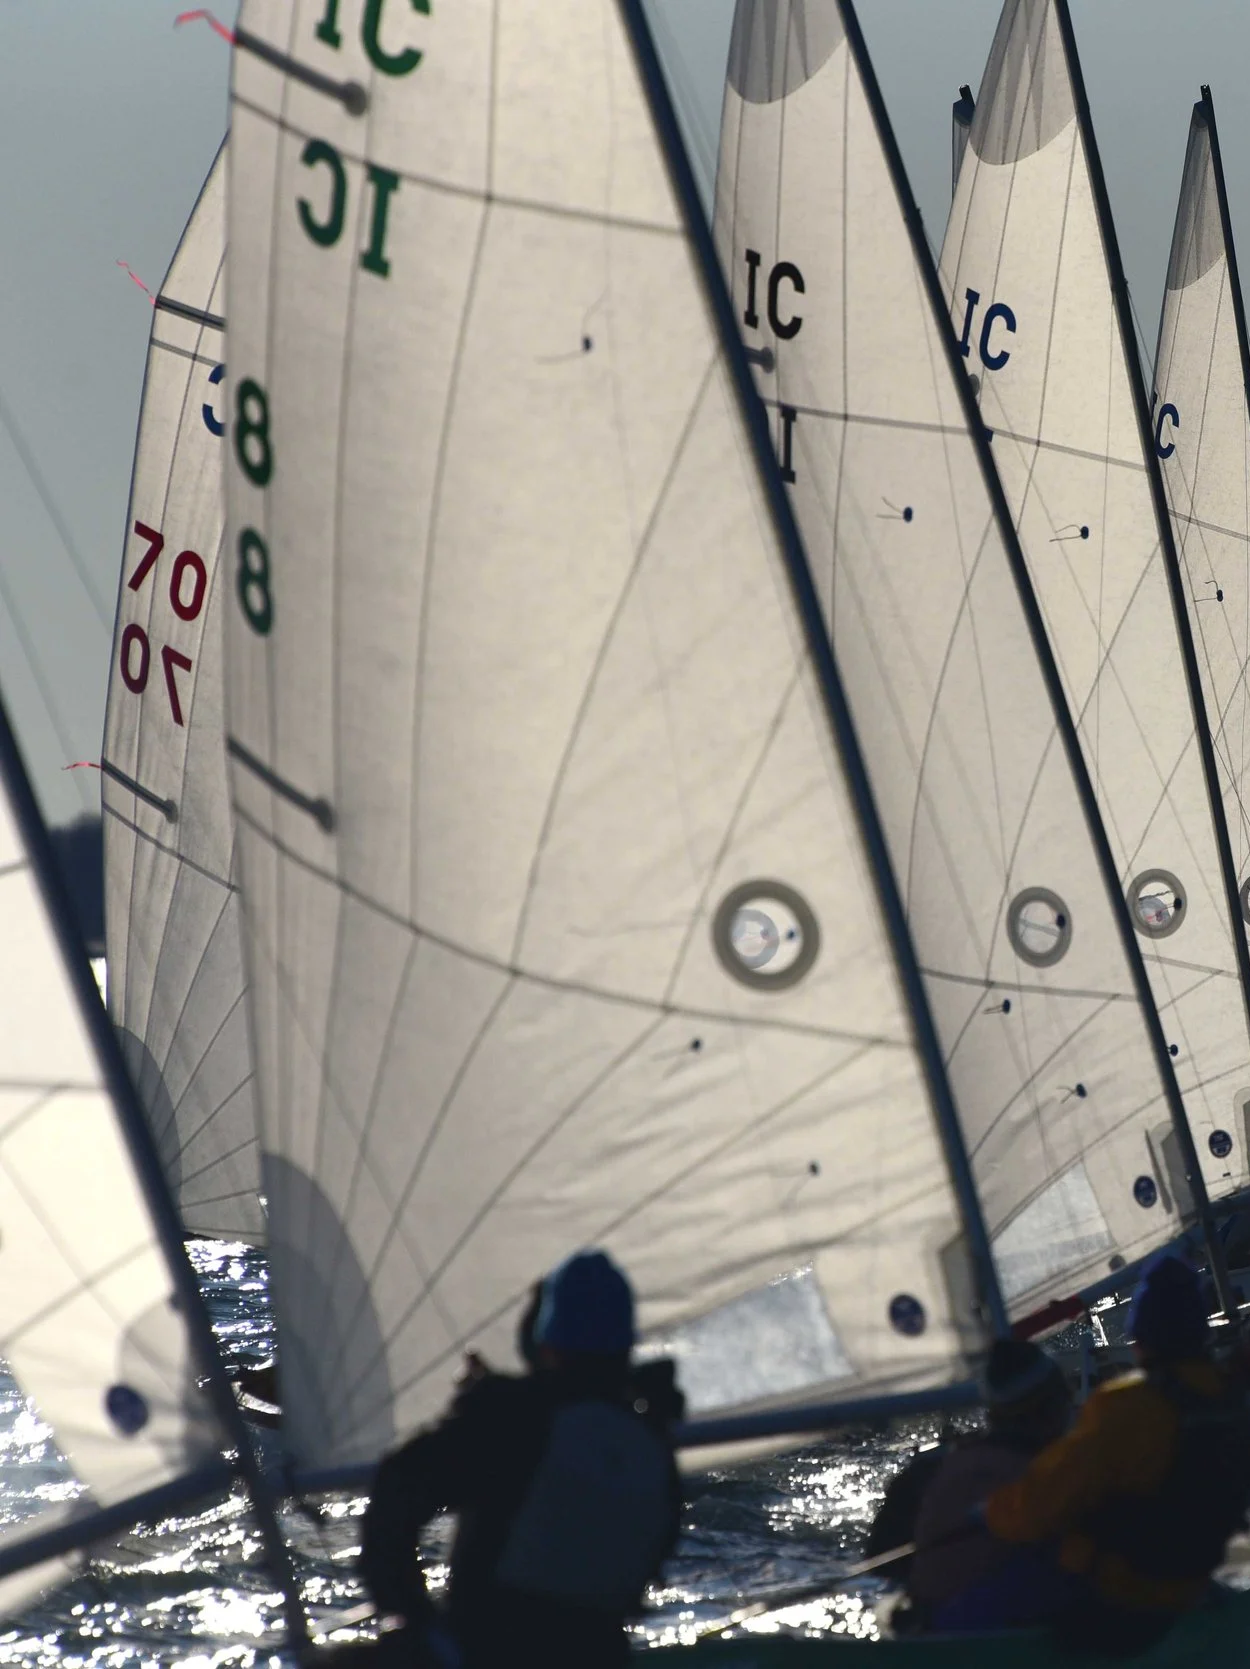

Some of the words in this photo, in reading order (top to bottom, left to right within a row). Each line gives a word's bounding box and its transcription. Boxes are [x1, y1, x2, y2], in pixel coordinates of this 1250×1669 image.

[743, 249, 806, 341] IC
[957, 288, 1017, 371] IC
[235, 377, 275, 489] 8
[127, 520, 207, 622] 70
